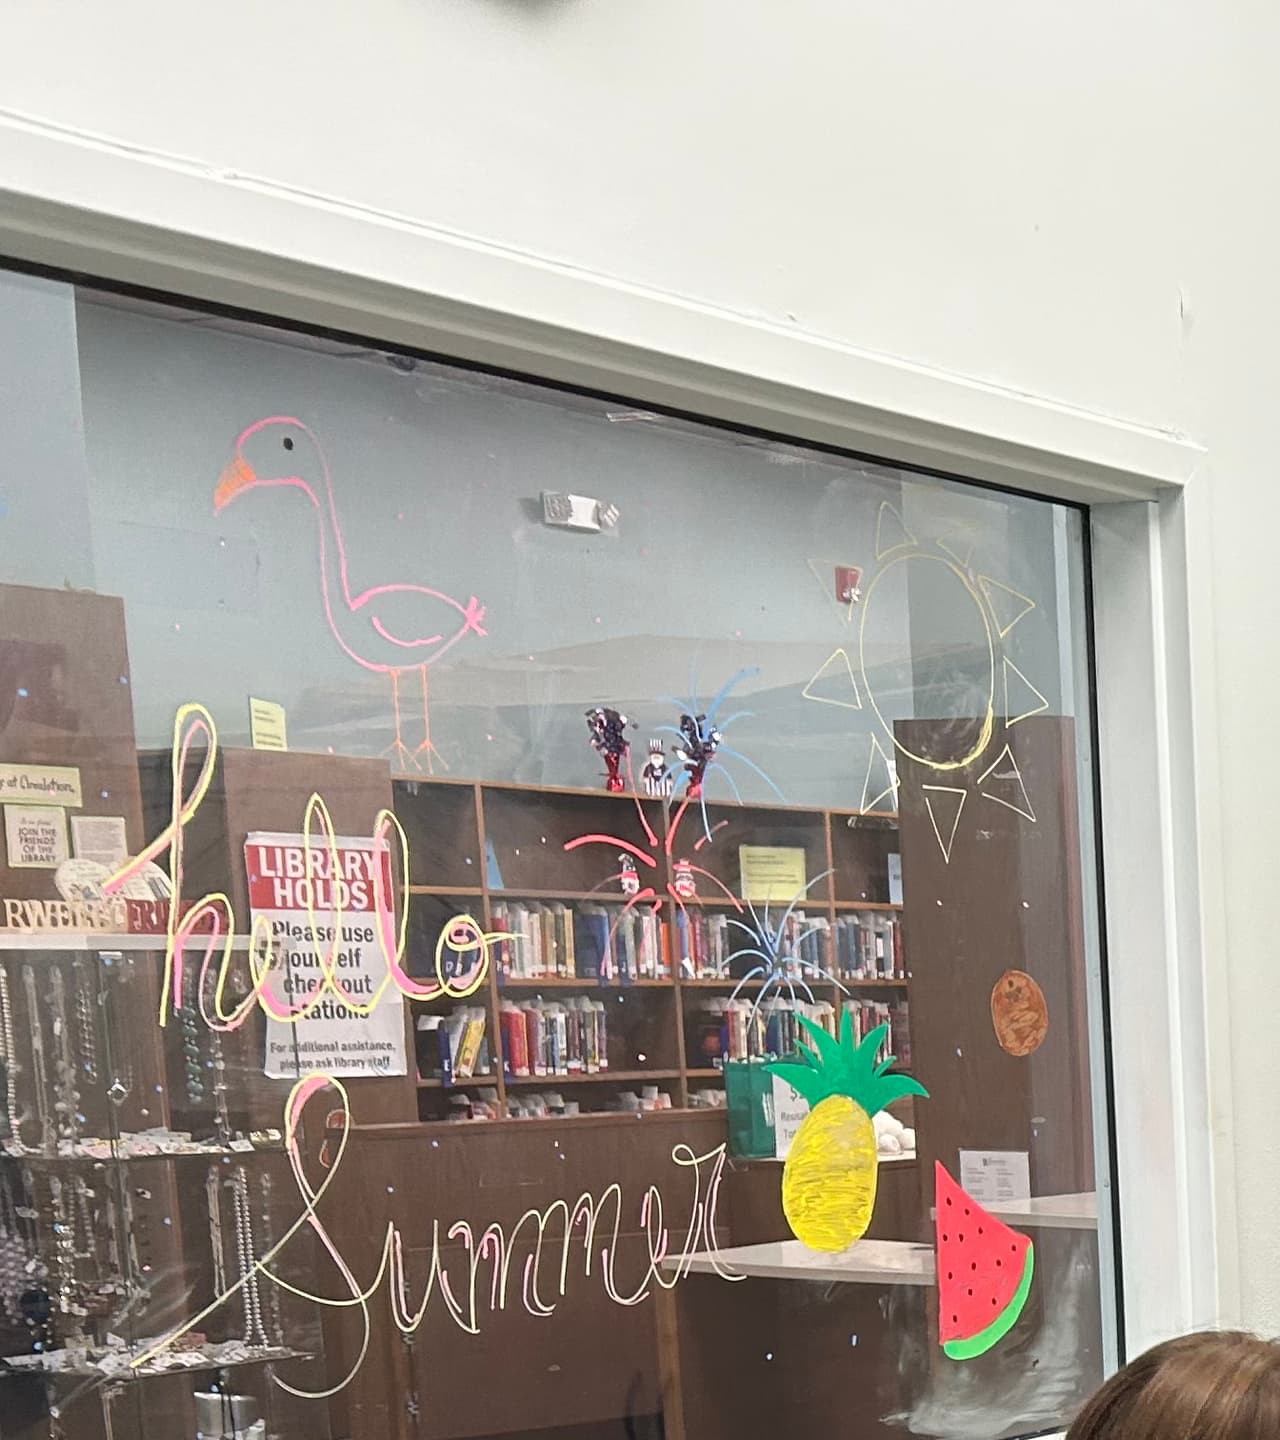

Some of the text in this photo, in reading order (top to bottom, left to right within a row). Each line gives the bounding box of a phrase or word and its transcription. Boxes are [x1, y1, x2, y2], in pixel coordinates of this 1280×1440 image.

[103, 703, 528, 1032] hello
[259, 847, 375, 880] LIBRARY
[273, 878, 369, 910] HOLDS
[342, 927, 374, 942] use
[315, 1057, 329, 1068] ask
[334, 1056, 365, 1069] library
[341, 1040, 396, 1053] assistance,
[129, 1071, 747, 1399] Summer
